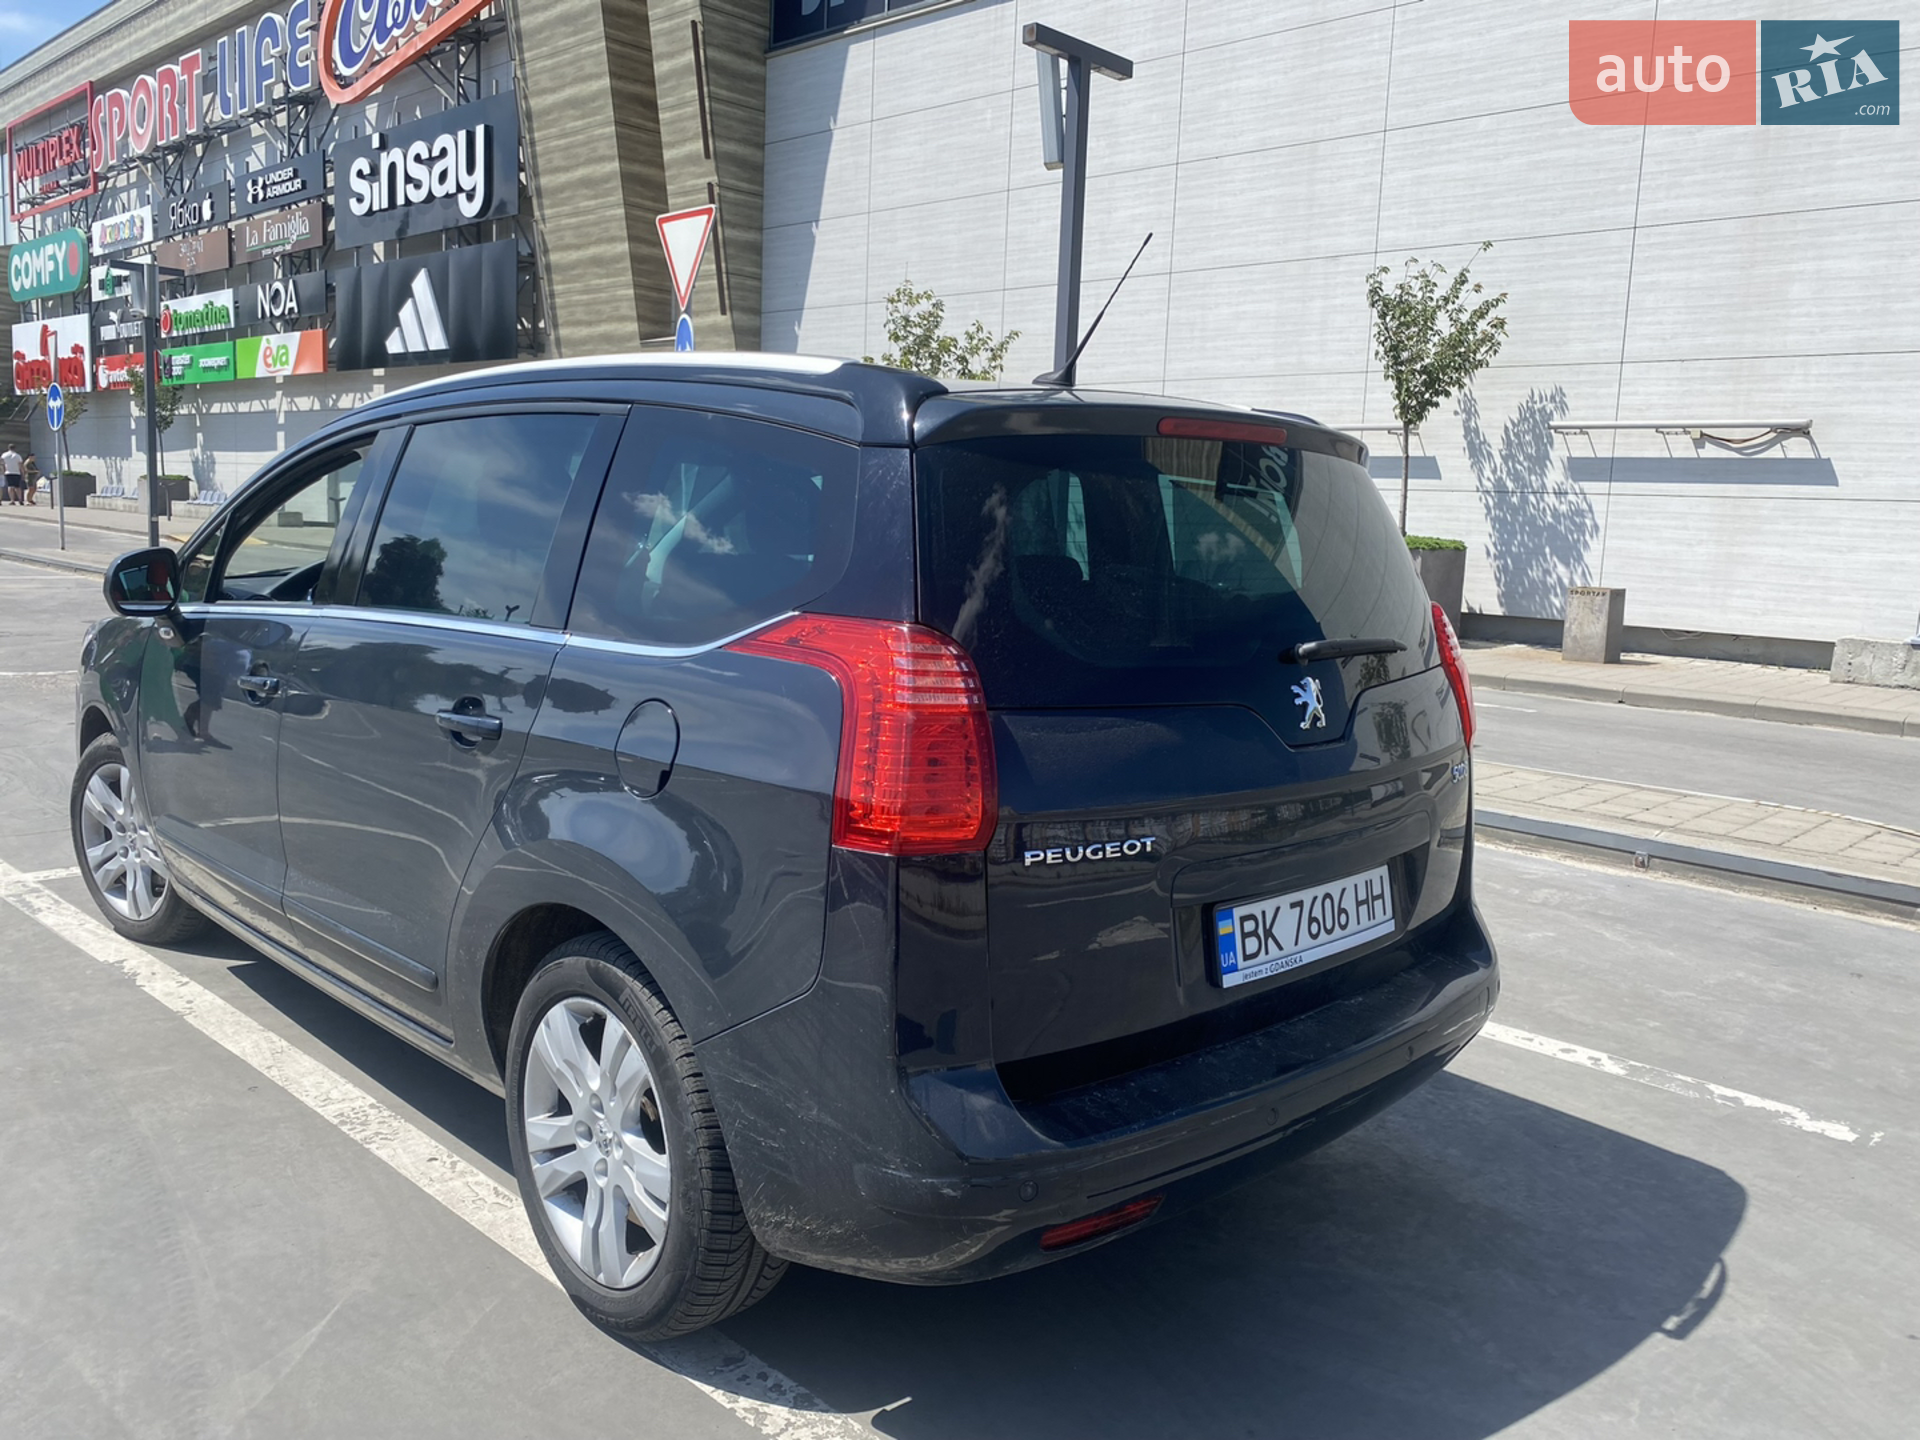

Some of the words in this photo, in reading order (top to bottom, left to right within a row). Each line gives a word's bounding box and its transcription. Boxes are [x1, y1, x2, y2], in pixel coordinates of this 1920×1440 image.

[92, 48, 202, 172] SPORT
[216, 0, 312, 119] LIFE
[15, 124, 83, 184] MULTIPLEX
[349, 123, 485, 218] sinsay
[264, 166, 294, 185] UNDER
[266, 179, 303, 199] ARMOUR
[169, 196, 199, 230] Ябко
[246, 226, 258, 247] La
[263, 212, 309, 243] Famiglia
[11, 240, 66, 292] COMFY
[173, 299, 230, 331] tomatina
[257, 278, 298, 319] NOA
[1024, 837, 1156, 866] PEUGEOT
[1239, 906, 1284, 962] BK
[1290, 887, 1349, 947] 7606
[1354, 875, 1387, 926] HH
[1221, 952, 1236, 967] UA
